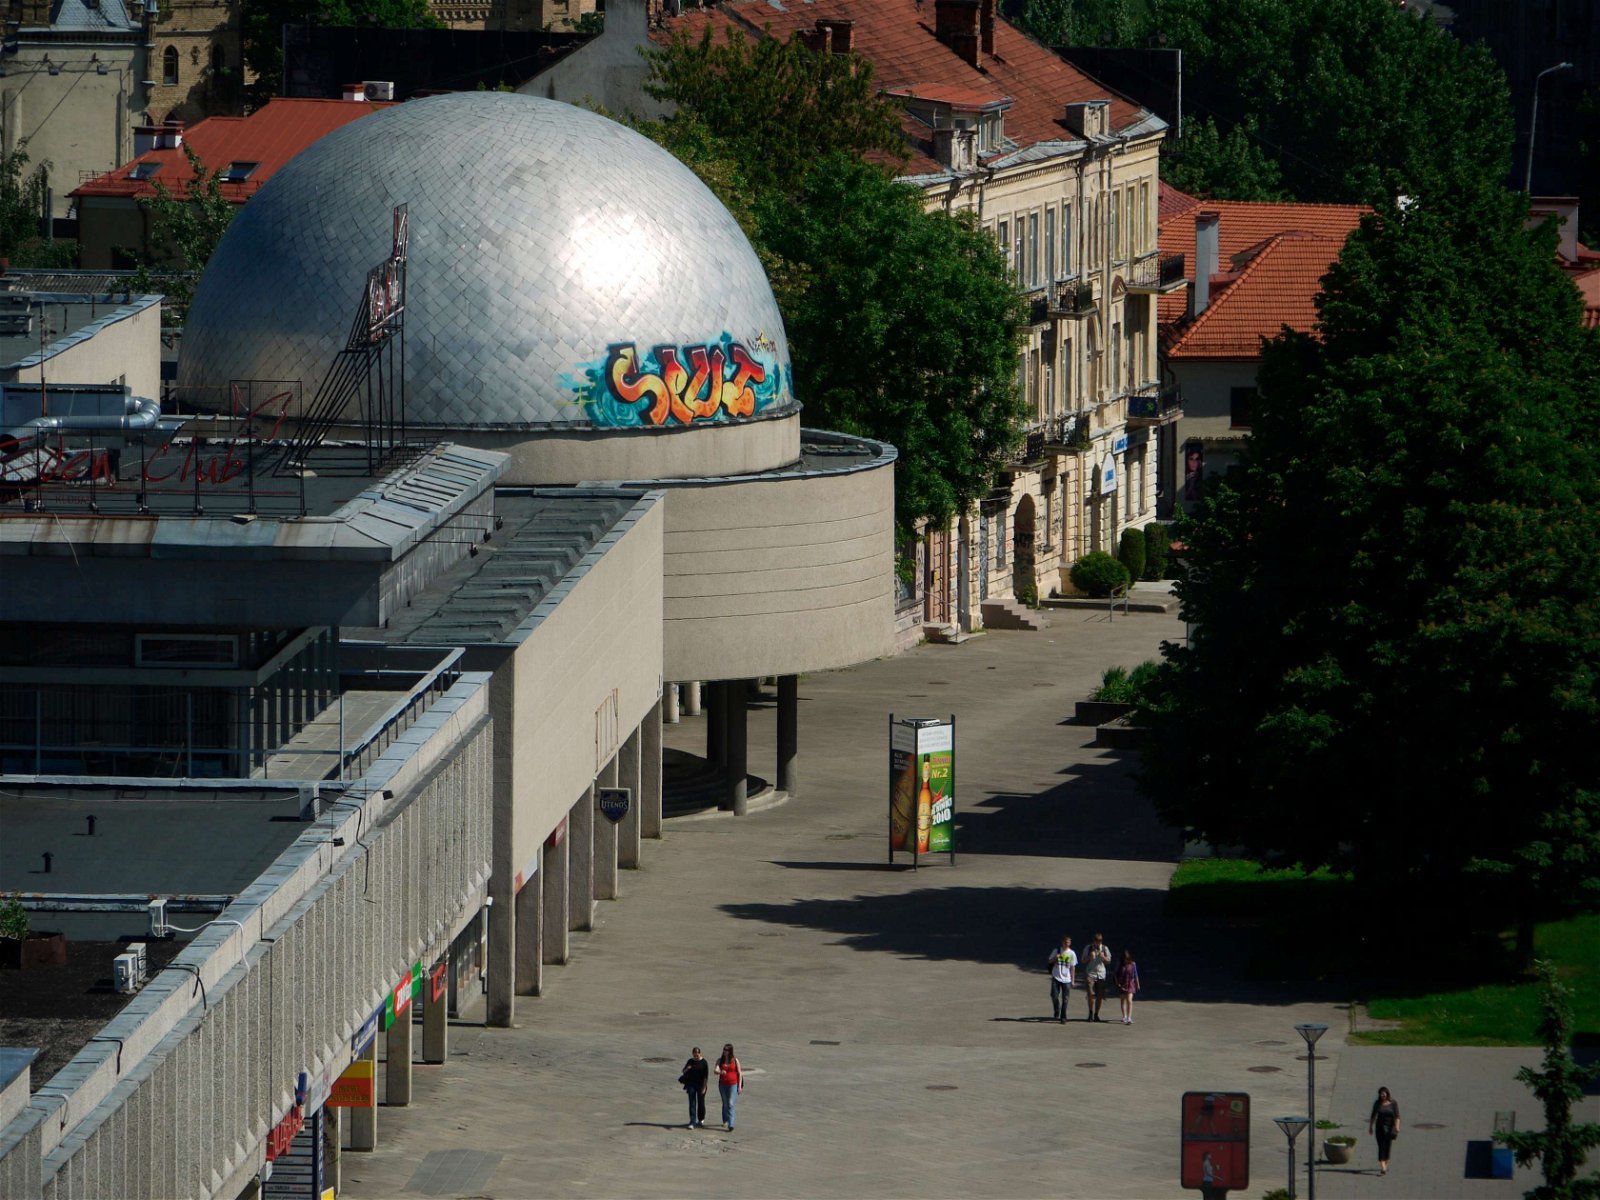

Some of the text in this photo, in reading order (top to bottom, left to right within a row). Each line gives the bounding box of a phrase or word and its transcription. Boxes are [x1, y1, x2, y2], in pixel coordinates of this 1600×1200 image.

[143, 434, 246, 485] Club
[931, 768, 949, 779] Nr.2
[601, 799, 628, 810] UTENOS
[931, 807, 952, 826] 2010
